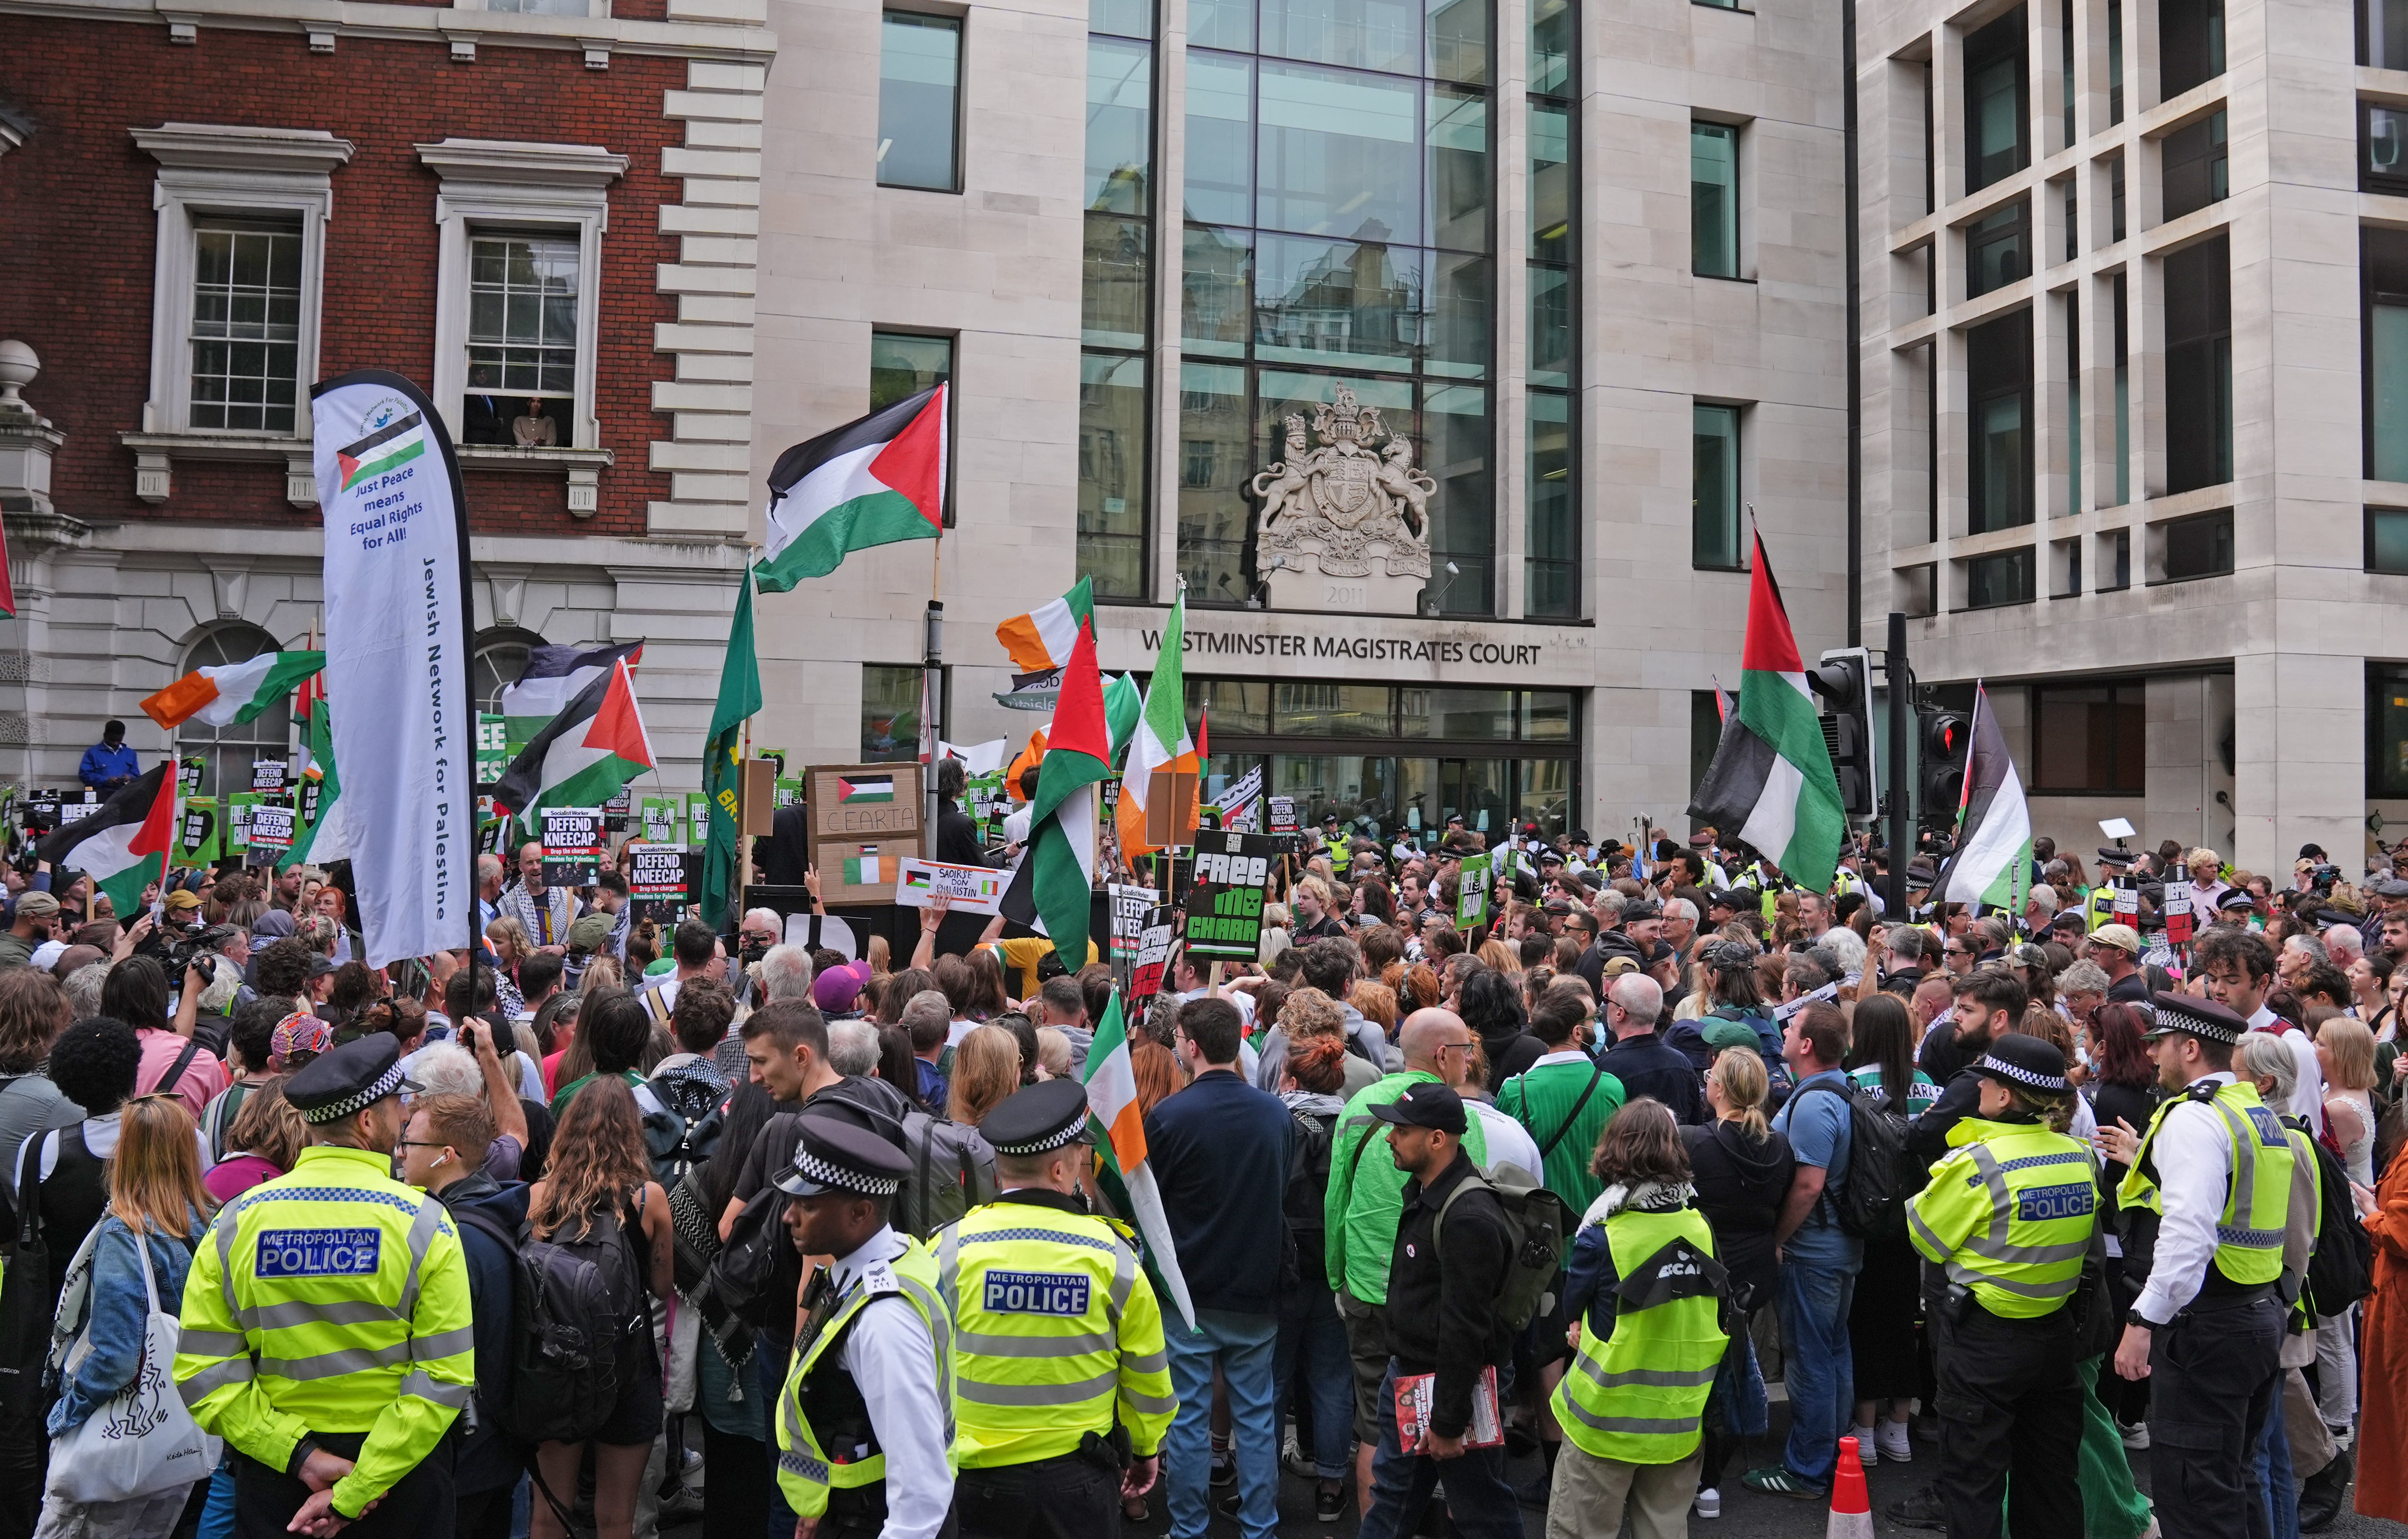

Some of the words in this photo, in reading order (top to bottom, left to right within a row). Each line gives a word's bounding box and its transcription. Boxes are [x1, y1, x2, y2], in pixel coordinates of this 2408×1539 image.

[356, 480, 378, 498] Just
[382, 467, 414, 488] Peace
[364, 490, 405, 512] means
[350, 513, 386, 536] Equal
[390, 500, 423, 523] Rights
[362, 536, 383, 550] for
[387, 528, 407, 545] All!
[1265, 555, 1297, 569] DEU
[1390, 559, 1427, 574] DROIT
[423, 558, 440, 637] Jewish
[1327, 586, 1364, 605] 2011
[1141, 629, 1306, 657] WSTMINSTER
[1313, 637, 1463, 664] MAGISTRATES
[1469, 642, 1541, 665] COURT
[428, 644, 447, 751] Network
[256, 768, 283, 778] DEFEND
[436, 757, 448, 794] for
[253, 778, 284, 788] KNEECAP
[606, 798, 630, 808] KNEECAP
[779, 789, 793, 806] FREE
[969, 787, 983, 804] FREE
[692, 803, 706, 821] FREE
[717, 788, 738, 823] BR
[1271, 804, 1293, 814] DEFEND
[230, 804, 246, 825] FREE
[256, 813, 291, 827] DEFEND
[643, 807, 659, 823] FREE
[1270, 814, 1296, 825] KNEECAP
[1633, 816, 1653, 828] 11
[252, 824, 293, 838] KNEECAP
[548, 817, 592, 832] DEFEND
[647, 824, 670, 841] CHARA
[544, 832, 596, 847] KNEECAP
[435, 803, 449, 921] Palestine
[637, 854, 680, 869] DEFEND
[633, 869, 684, 883] KNEECAP
[939, 868, 973, 879] SAOIRSE
[1460, 870, 1476, 895] FREE
[1479, 867, 1489, 890] MO
[2114, 888, 2137, 903] DEFEND
[2164, 881, 2190, 901] DEFEND
[1462, 892, 1483, 918] CHARA
[2096, 898, 2113, 912] POLI
[1139, 924, 1172, 951] DEFEND
[1187, 916, 1258, 942] CHARA
[1479, 1110, 1506, 1124] Genocide
[2019, 1183, 2092, 1200] METROPOLITAN
[2020, 1194, 2093, 1218] POLICE
[263, 1232, 375, 1245] METROPOLITAN
[262, 1246, 373, 1272] POLICE
[989, 1273, 1086, 1286] METROPOLITAN
[987, 1284, 1086, 1312] POLICE
[1414, 1388, 1421, 1399] OF
[1421, 1401, 1427, 1413] WE
[1483, 1390, 1496, 1425] COUNTERFIRE
[1491, 1425, 1499, 1437] JOIN
[166, 1451, 184, 1461] Keith
